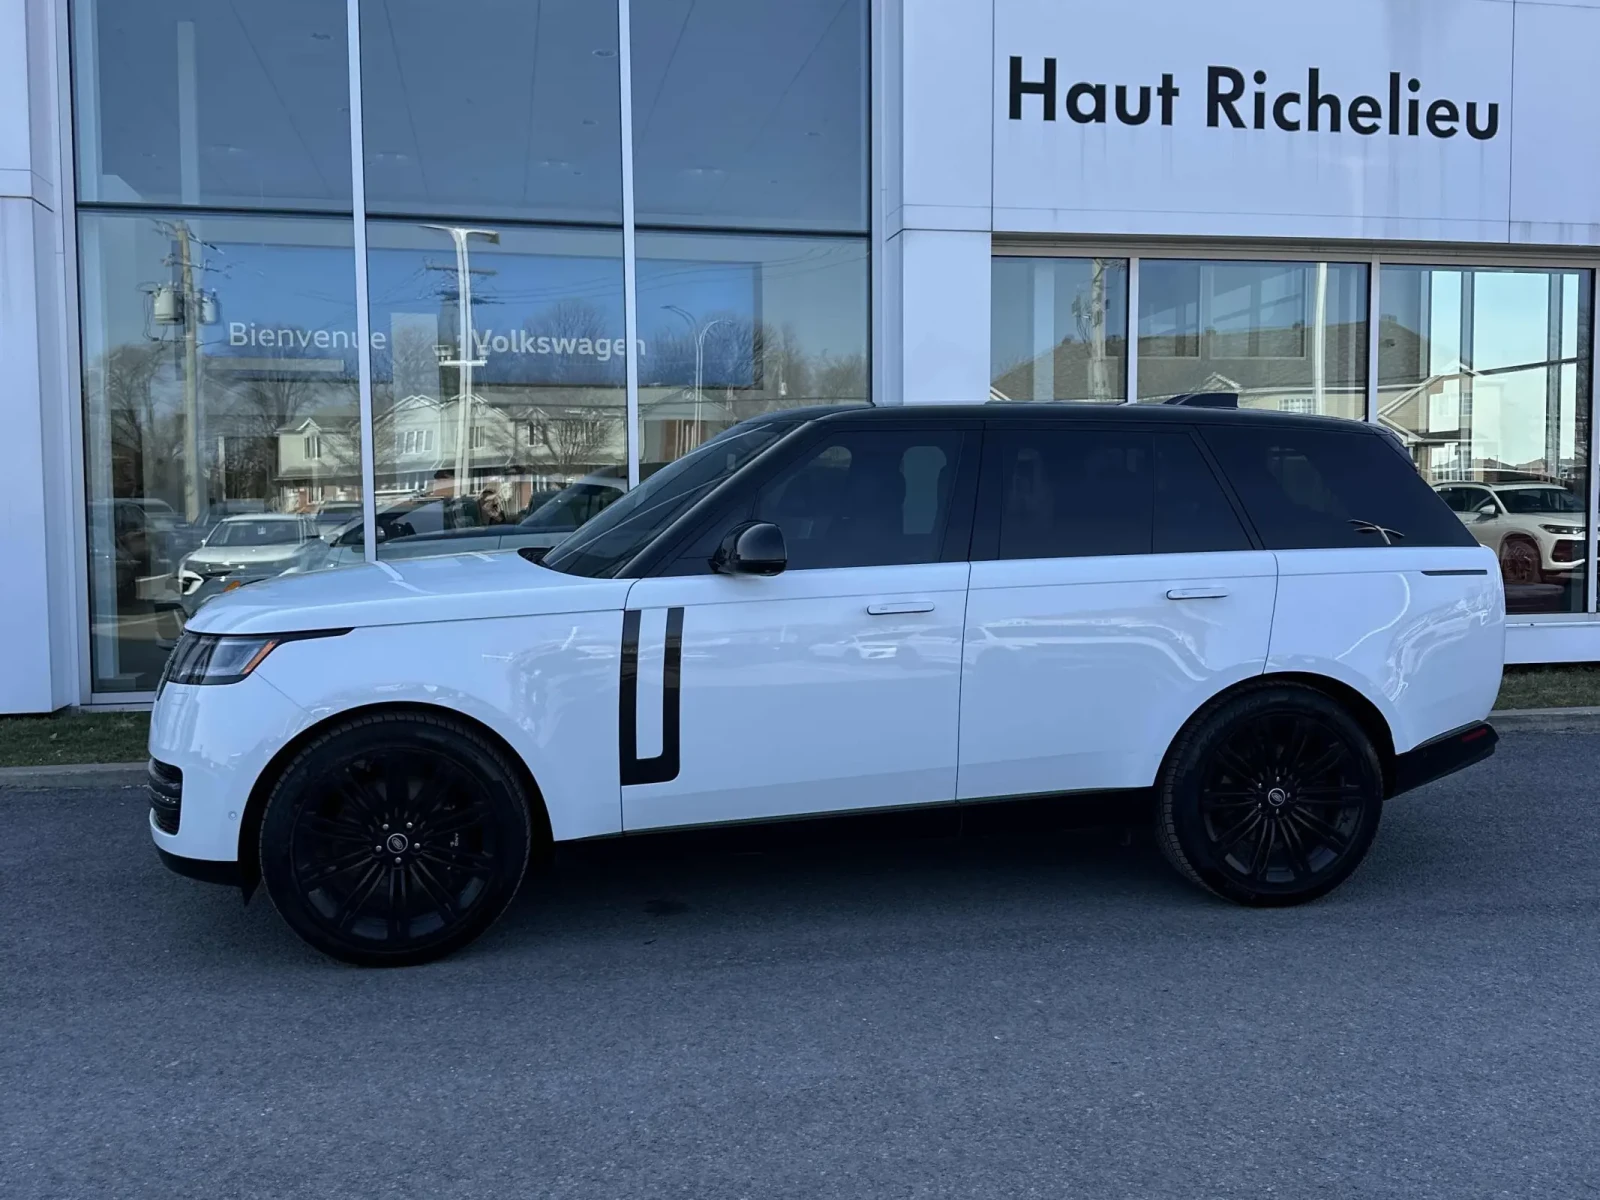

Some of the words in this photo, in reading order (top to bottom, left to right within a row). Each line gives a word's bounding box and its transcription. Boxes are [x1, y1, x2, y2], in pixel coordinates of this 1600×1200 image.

[1009, 55, 1180, 126] Haut
[1206, 65, 1499, 141] Richelieu
[472, 328, 646, 361] Volkswagen
